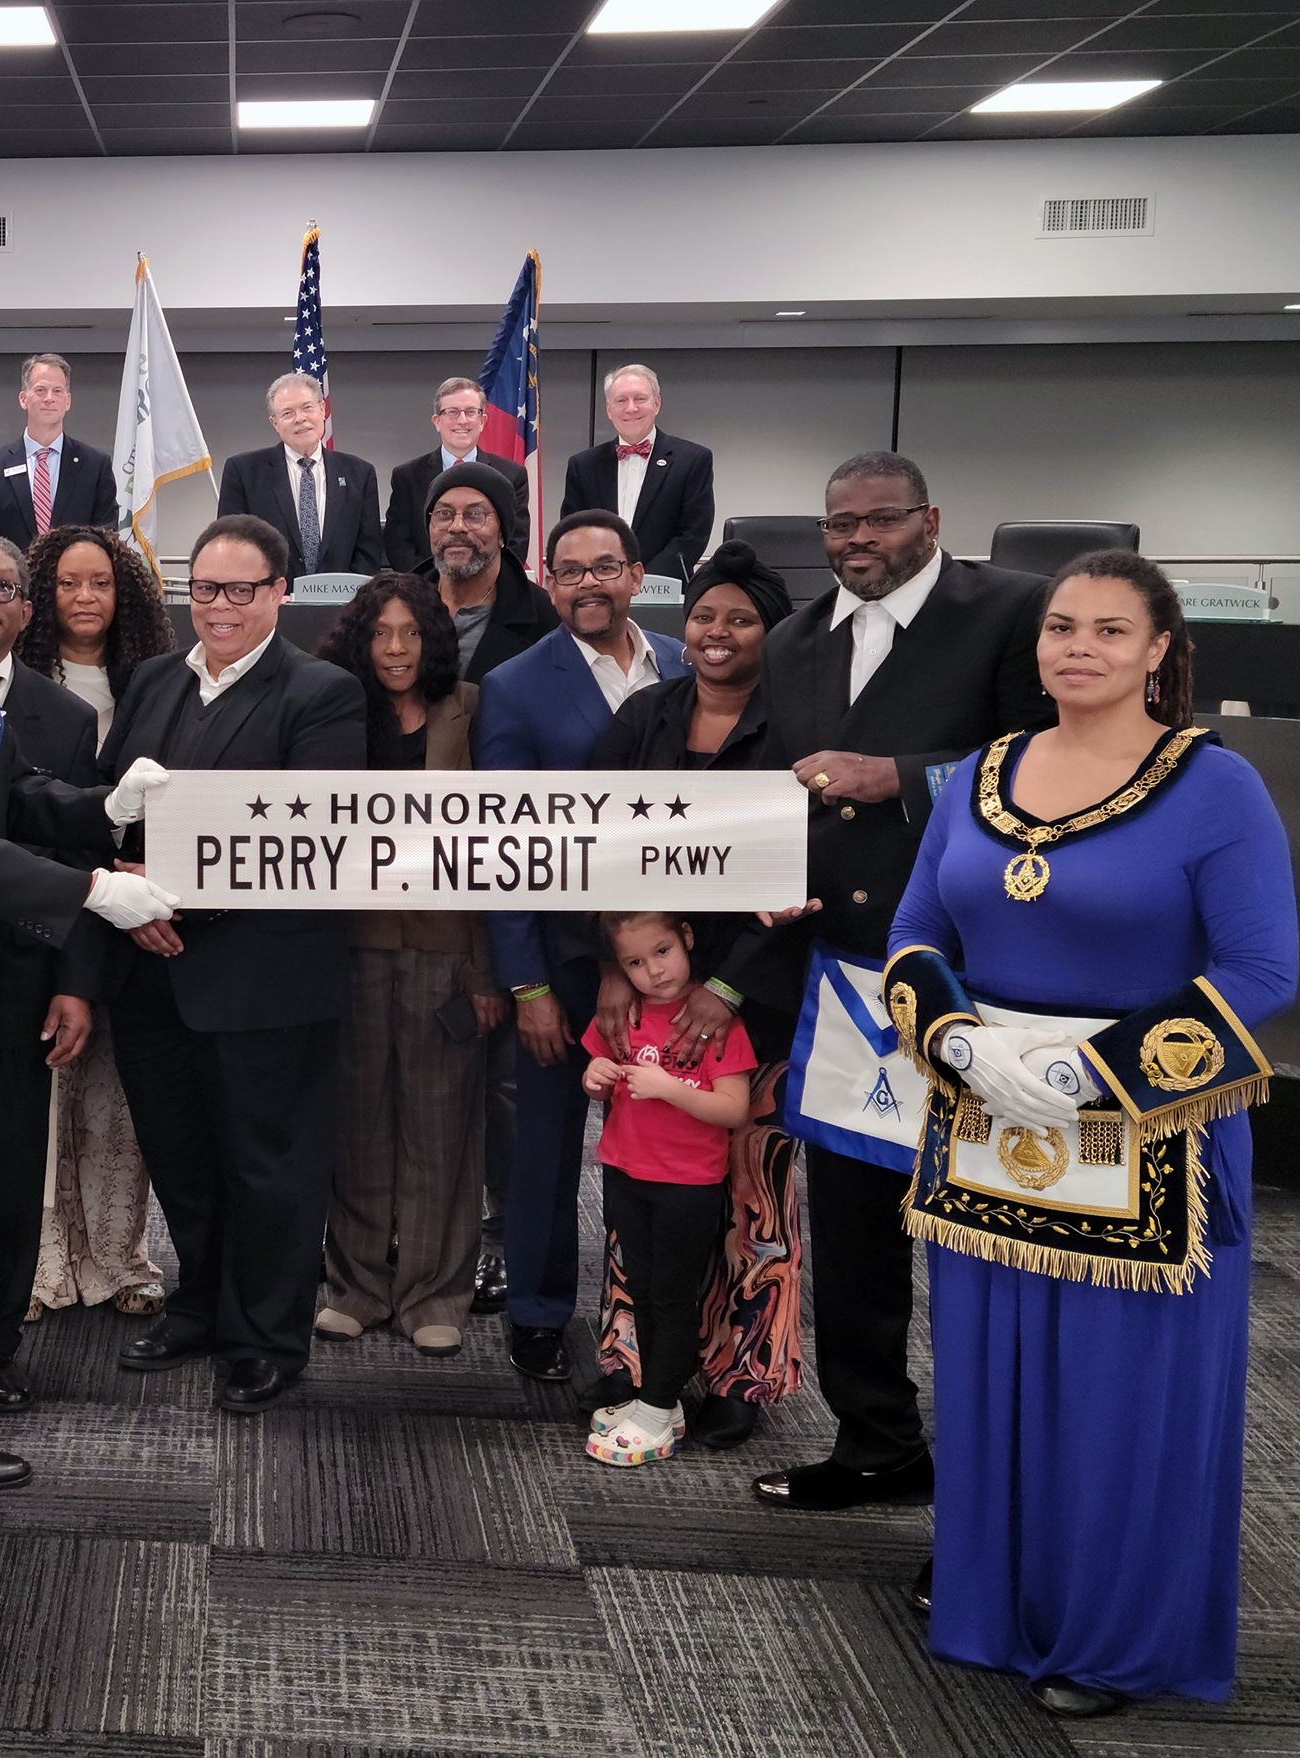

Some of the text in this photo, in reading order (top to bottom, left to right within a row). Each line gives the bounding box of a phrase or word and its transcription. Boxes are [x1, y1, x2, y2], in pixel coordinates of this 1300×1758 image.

[302, 584, 329, 593] MIKE
[1200, 597, 1260, 609] GRATWICK
[330, 792, 612, 825] HONORARY
[196, 835, 732, 892] PERRY P. NESBIT PKWY
